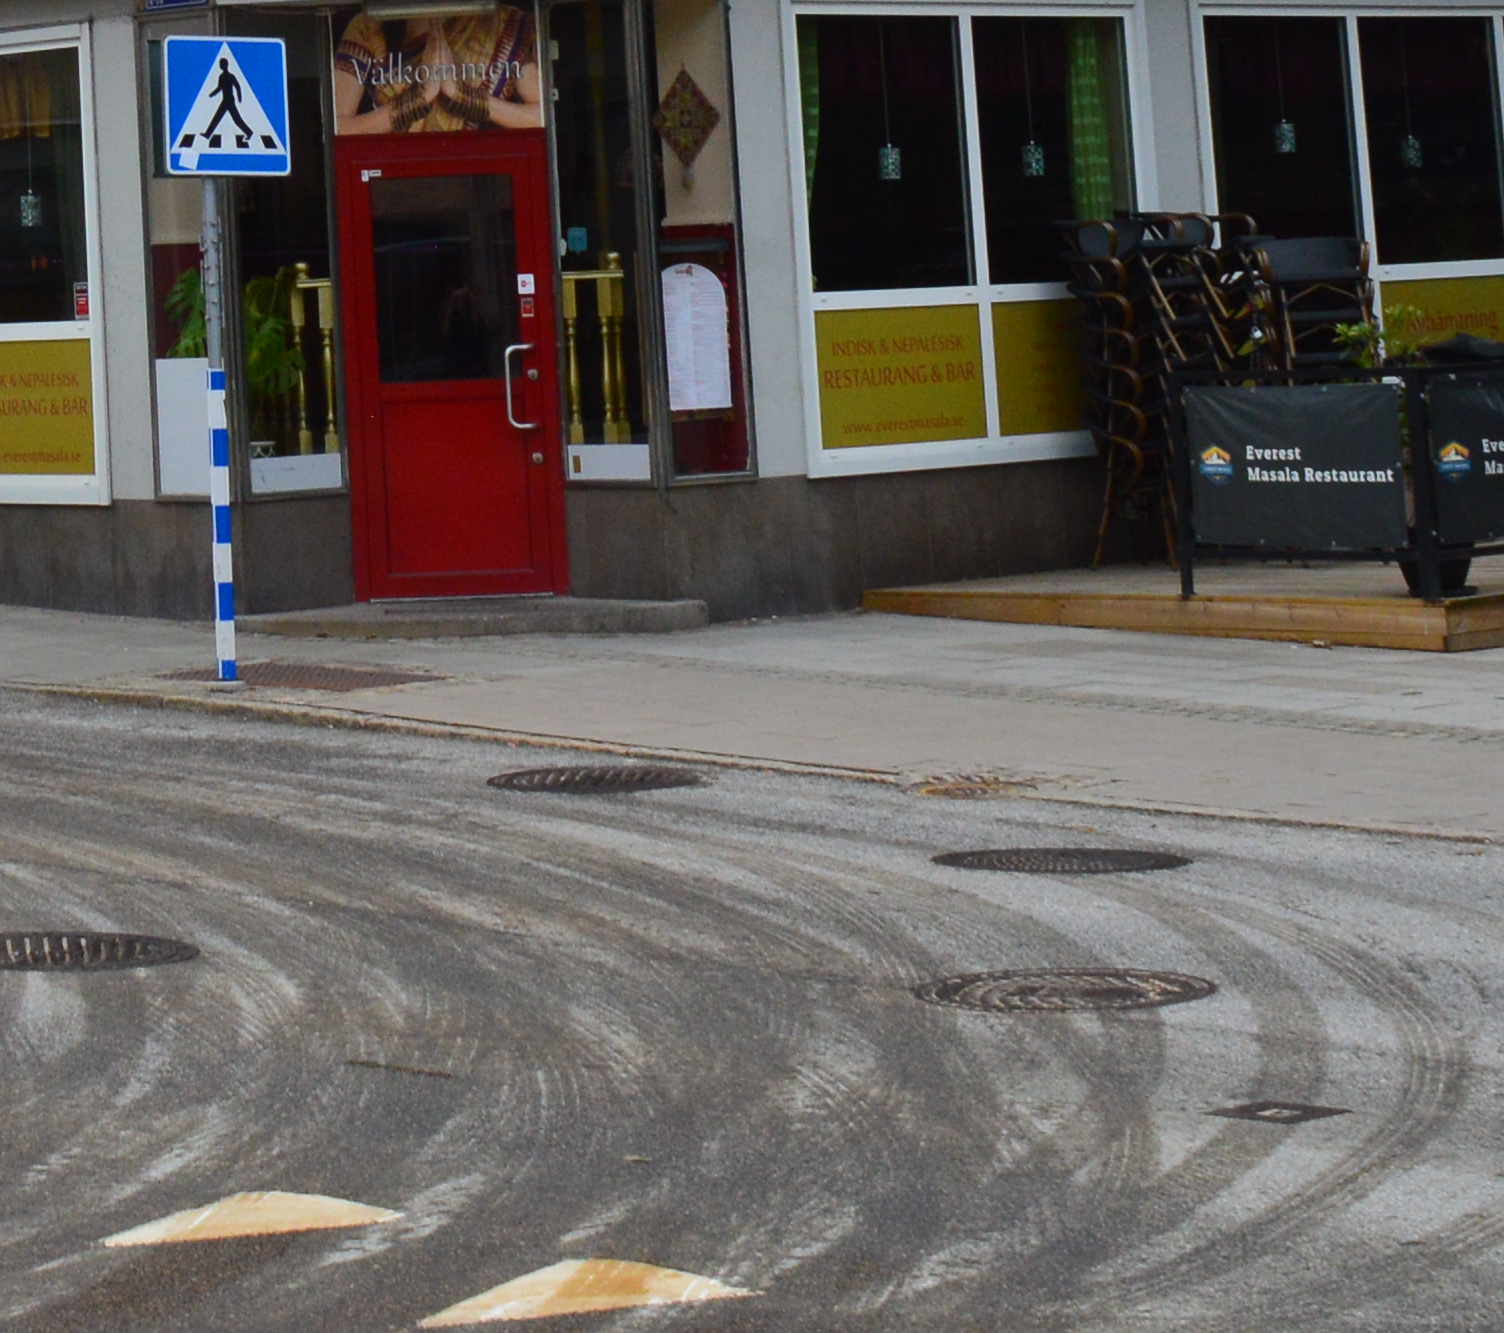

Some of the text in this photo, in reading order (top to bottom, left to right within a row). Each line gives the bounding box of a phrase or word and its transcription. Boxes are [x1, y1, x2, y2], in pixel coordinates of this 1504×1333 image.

[351, 52, 525, 86] Välkommen
[832, 339, 877, 357] INDISK
[824, 362, 976, 389] RESTAURANG & BAR
[50, 399, 59, 415] &
[63, 398, 88, 415] BAR
[1245, 445, 1302, 461] Everest
[1247, 467, 1300, 482] Masala
[1304, 467, 1394, 482] Restaurant
